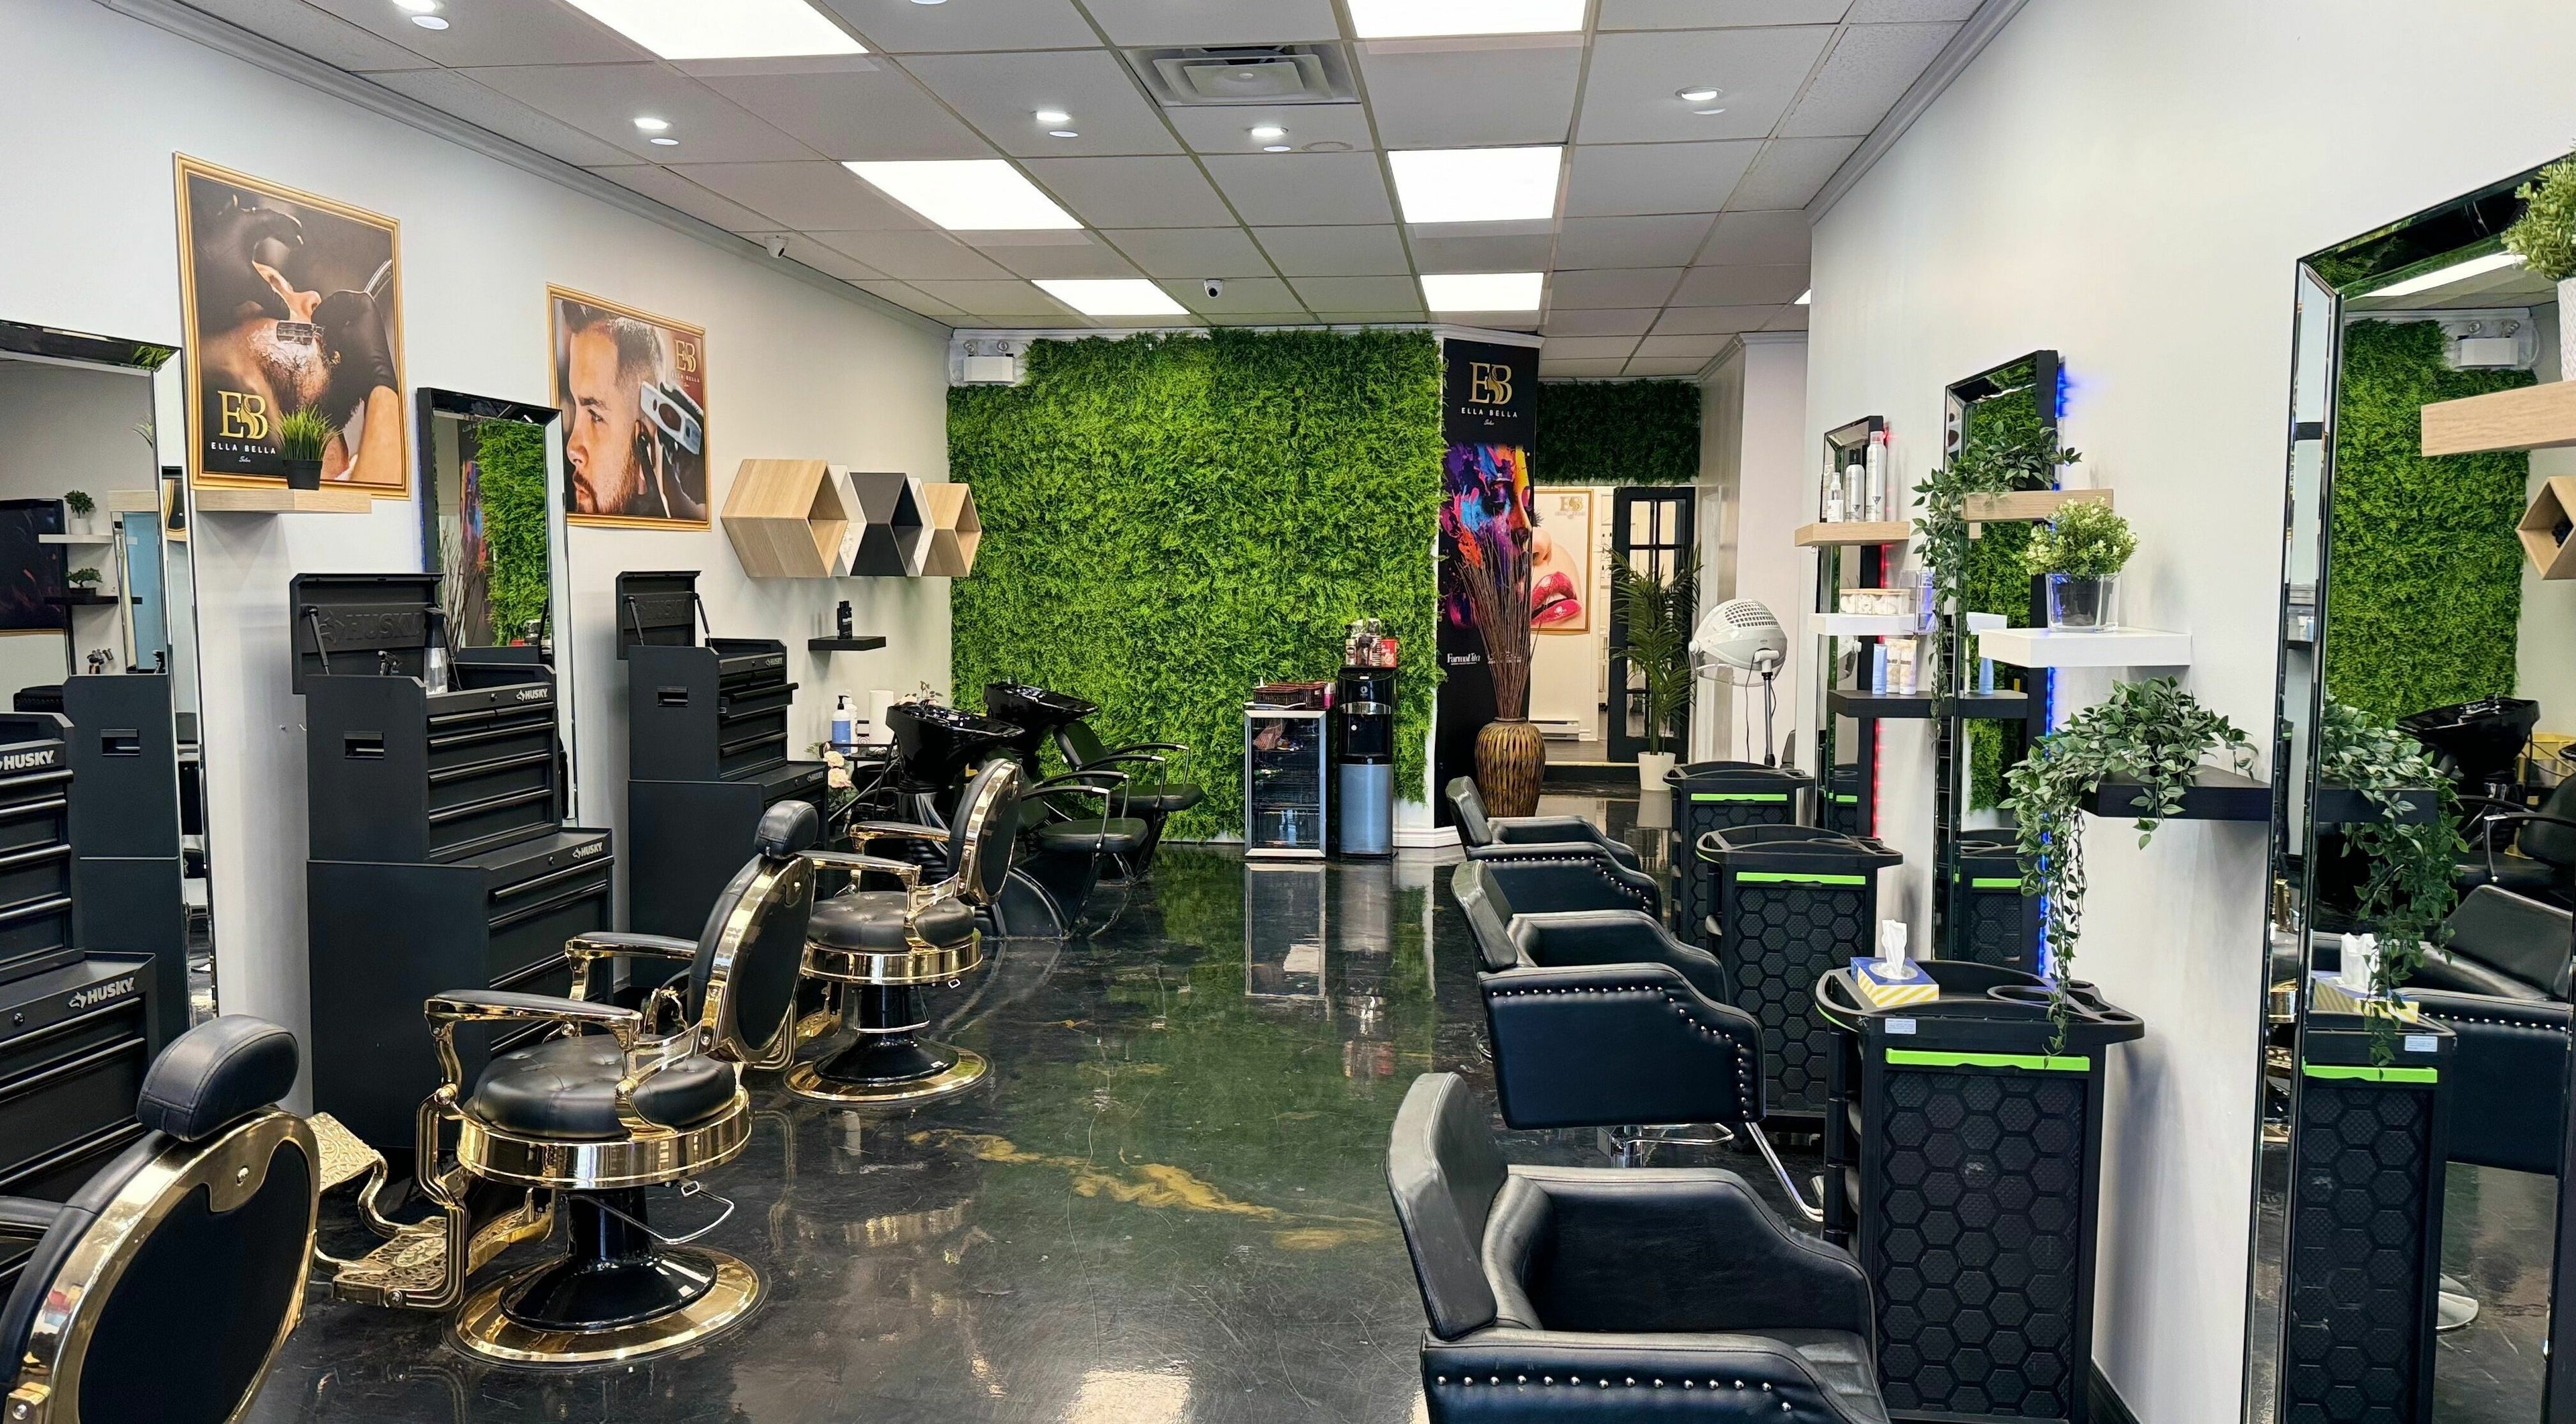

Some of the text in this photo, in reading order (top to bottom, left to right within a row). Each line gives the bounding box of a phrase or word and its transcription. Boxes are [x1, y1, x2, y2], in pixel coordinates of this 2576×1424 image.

[1461, 407, 1517, 418] ELLA BELLA
[211, 441, 276, 455] ELLA BELLA
[345, 612, 421, 641] HUSKY
[525, 688, 548, 700] HUSKY
[3, 749, 54, 771] HUSKY
[581, 841, 603, 857] HUSKY
[86, 977, 135, 1005] HUSKY
